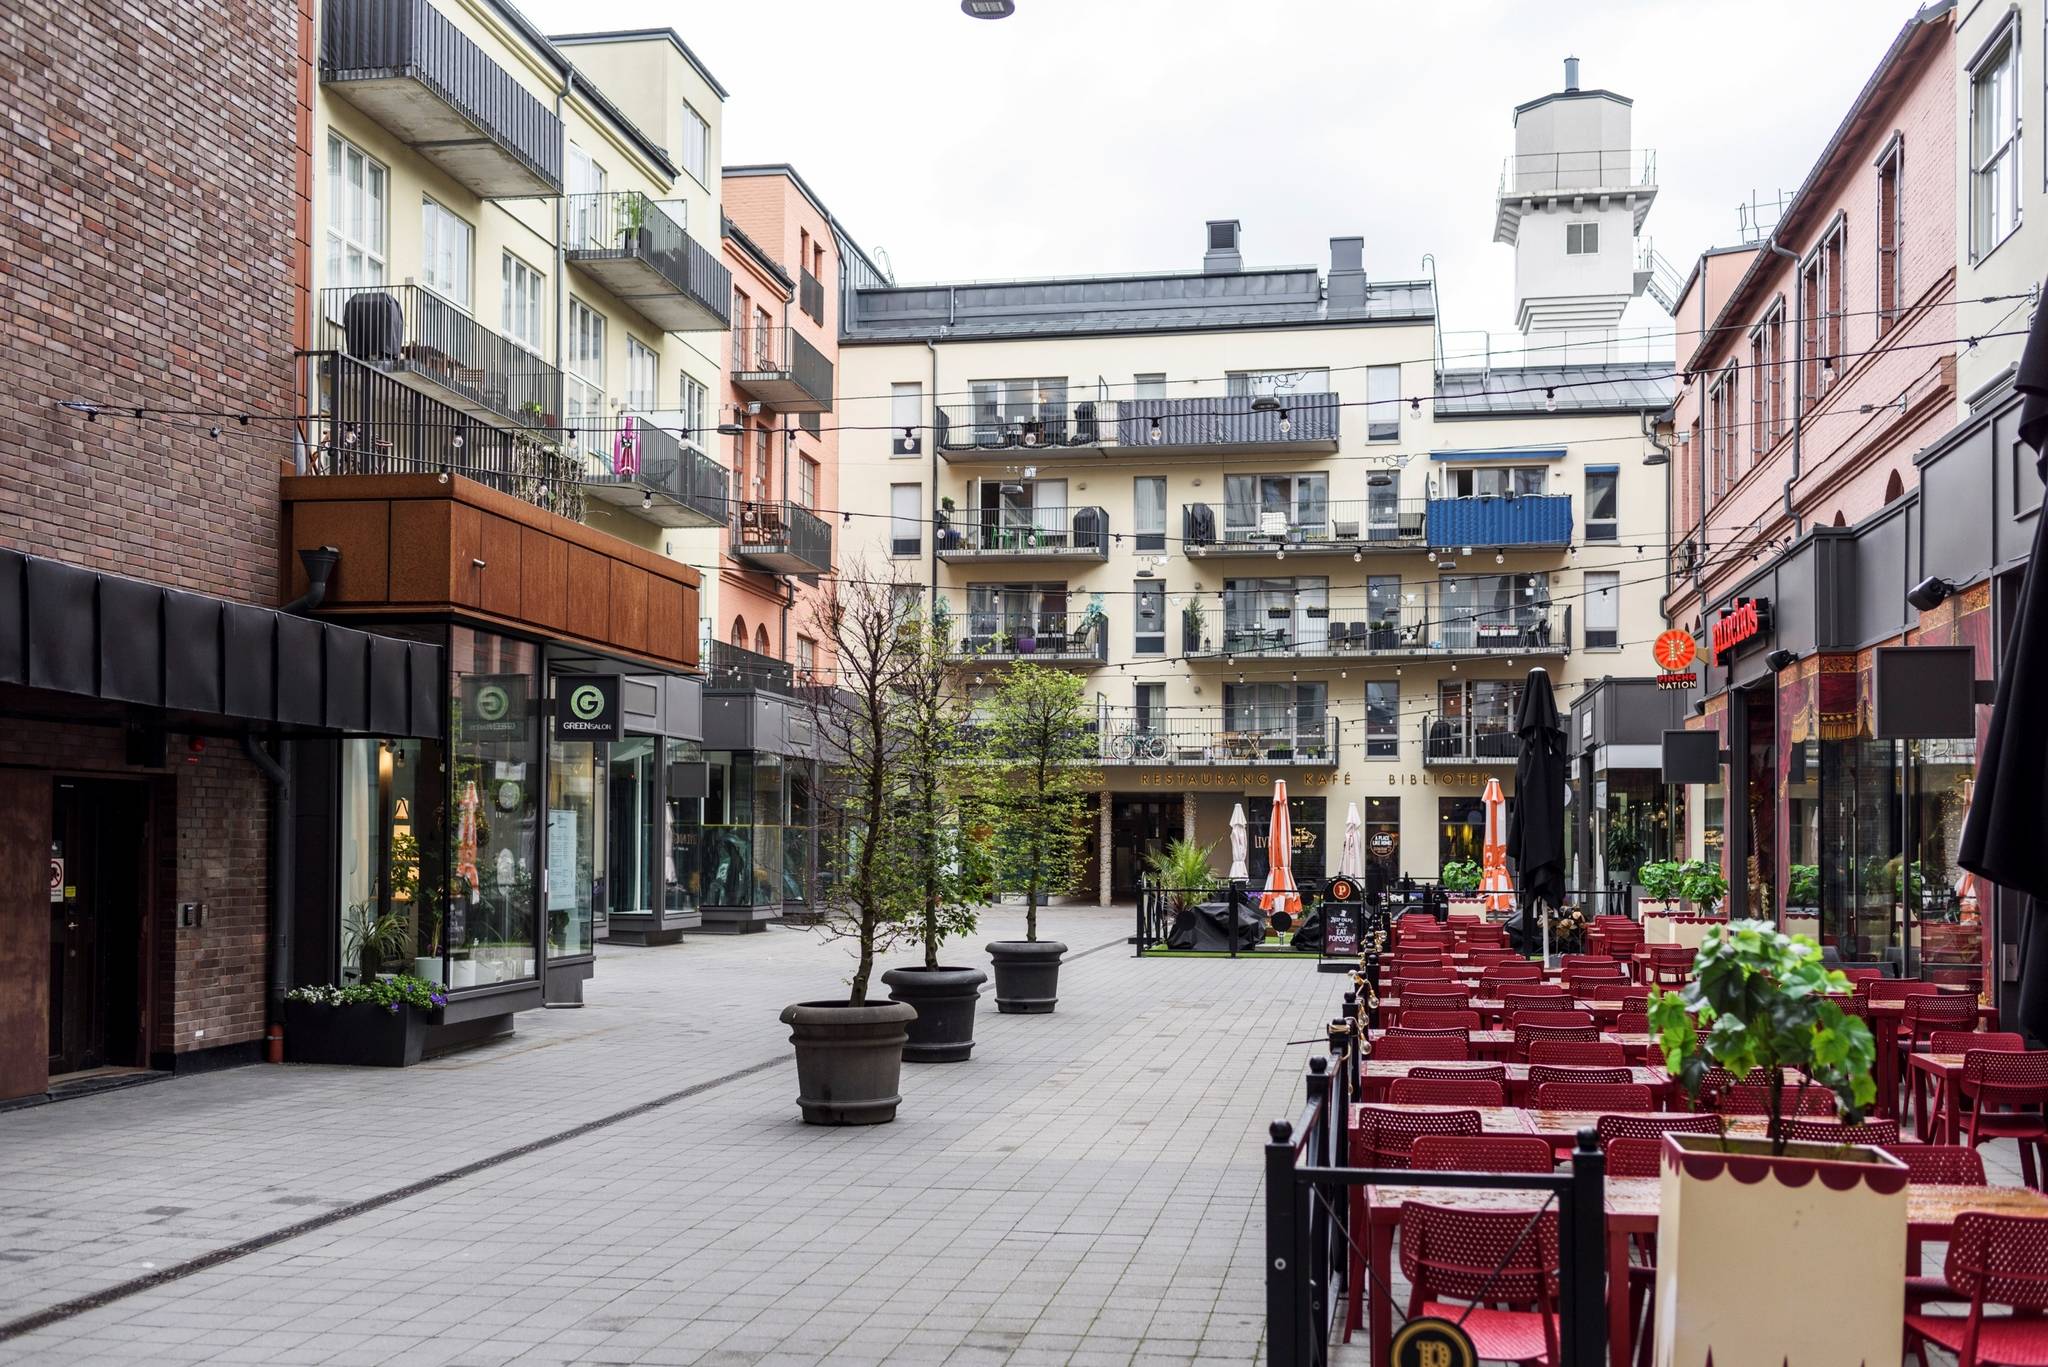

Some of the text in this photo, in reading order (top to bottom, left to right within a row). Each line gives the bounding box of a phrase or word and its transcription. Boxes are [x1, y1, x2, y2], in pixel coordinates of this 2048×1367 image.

[1712, 597, 1758, 668] pinchos
[1667, 639, 1685, 661] P
[1657, 673, 1697, 683] PINCHO
[1658, 681, 1697, 690] NATION
[576, 690, 599, 715] G
[1140, 771, 1491, 786] RESTAURANG KAFÉ BIBLIOTEK
[1337, 885, 1347, 896] P
[1336, 928, 1347, 936] EAT
